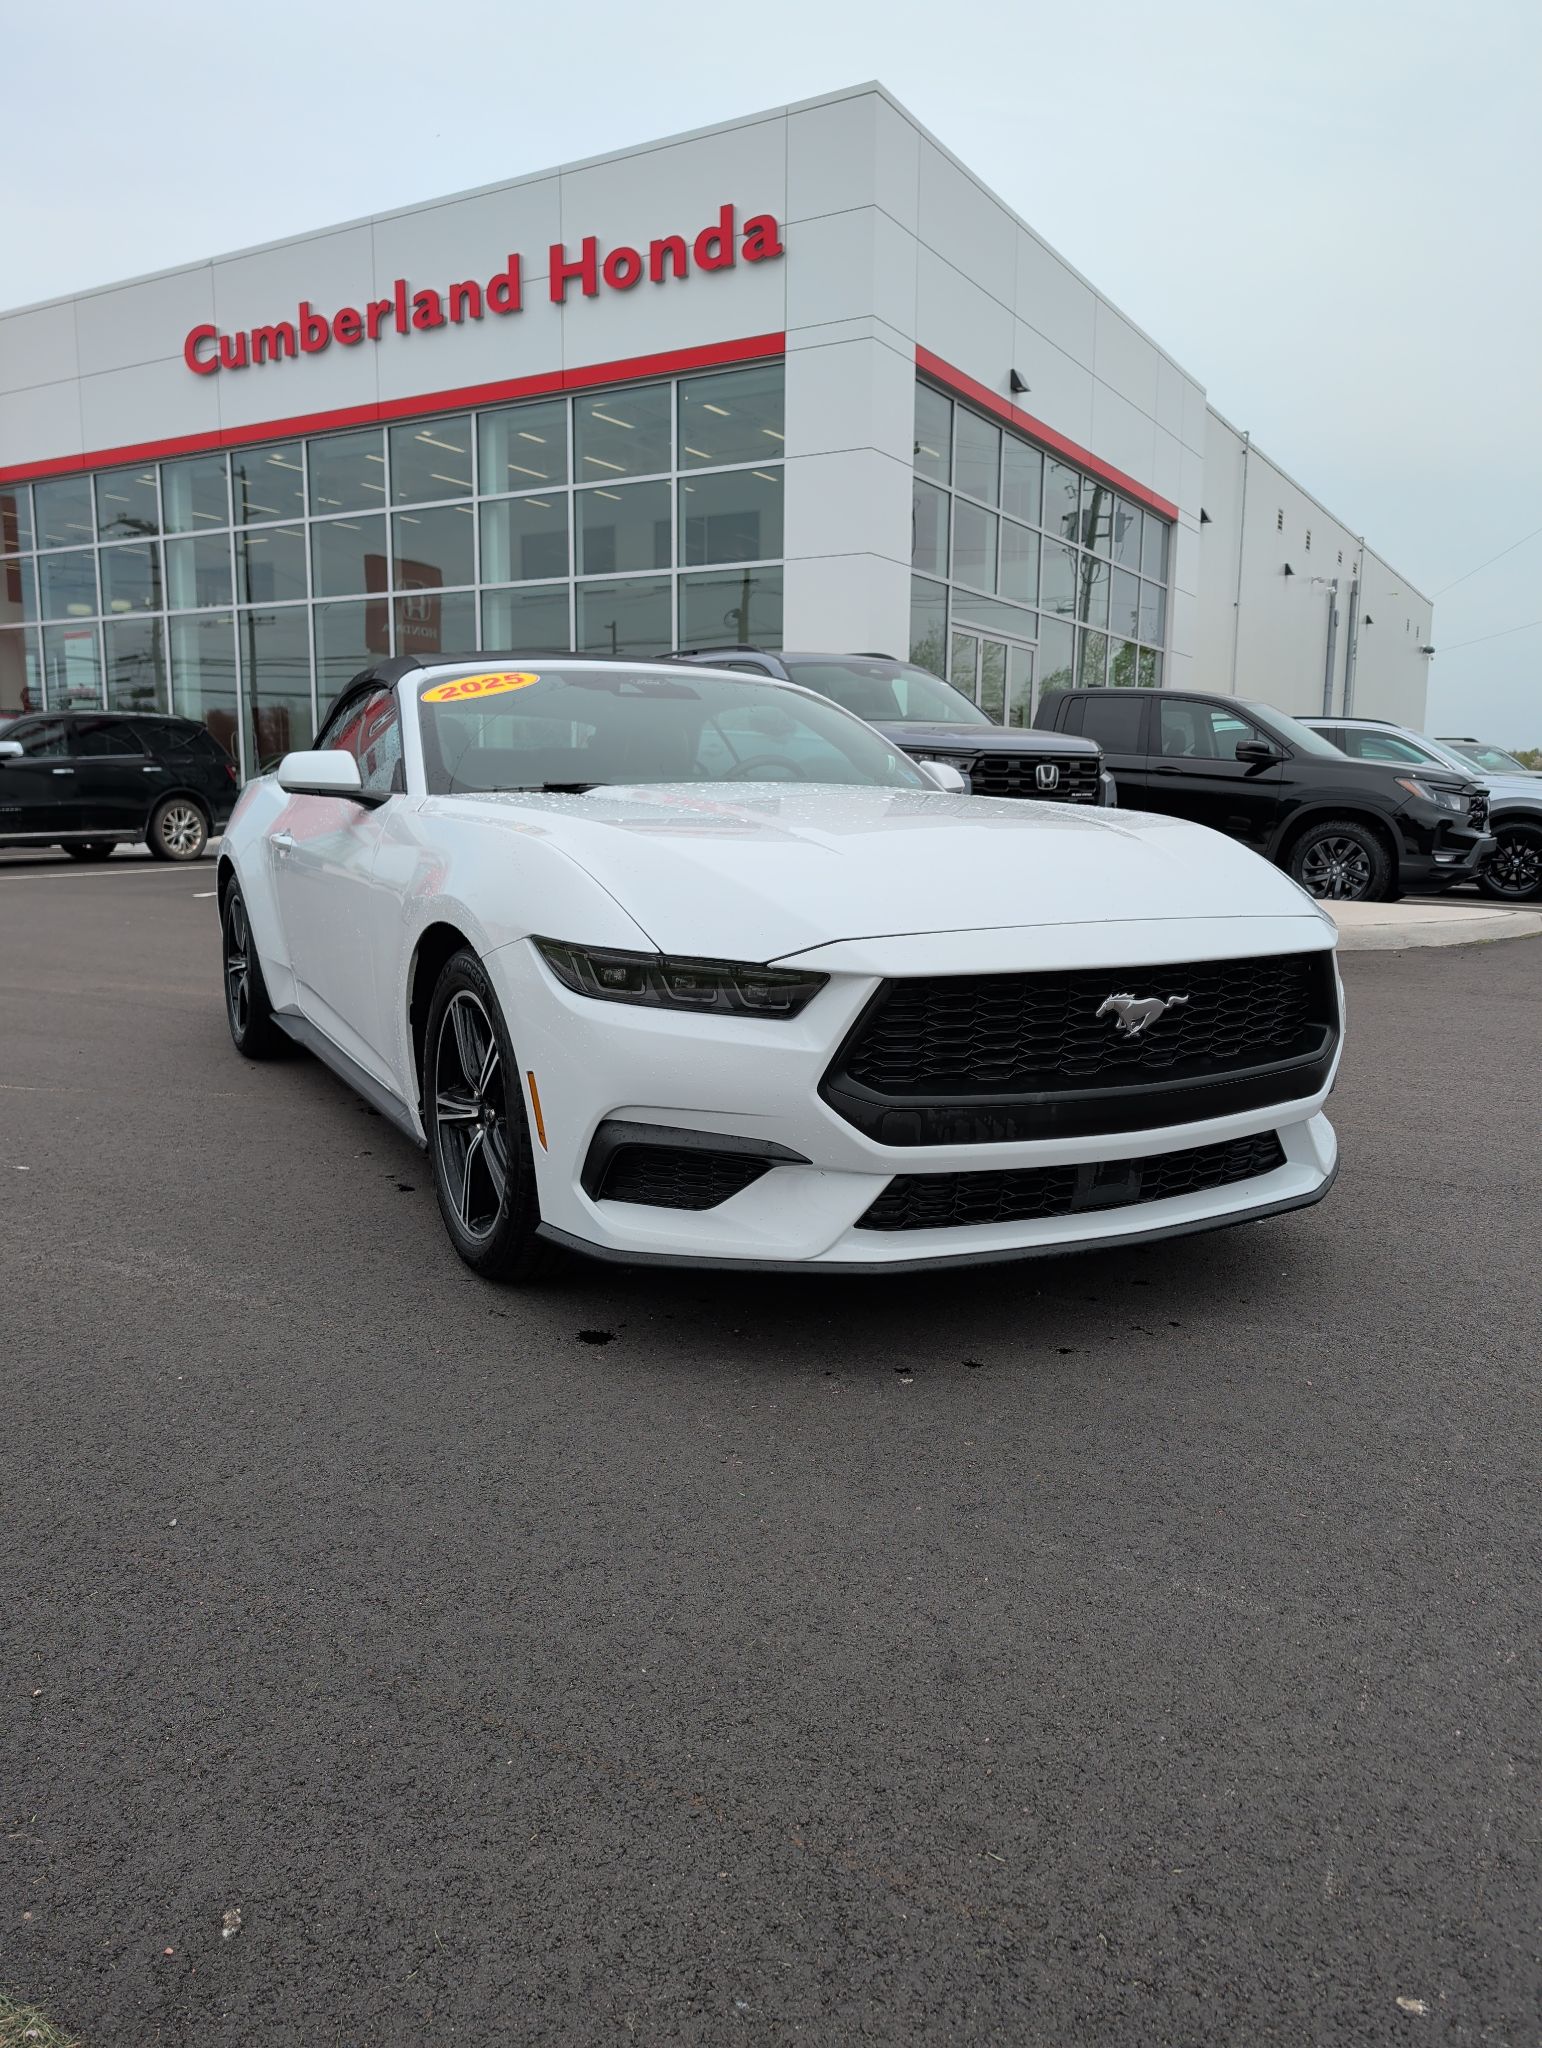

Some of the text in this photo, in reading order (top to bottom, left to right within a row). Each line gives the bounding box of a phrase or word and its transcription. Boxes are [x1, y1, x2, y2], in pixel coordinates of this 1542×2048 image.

[185, 204, 784, 375] Cumberland Honda
[439, 674, 524, 700] 2025
